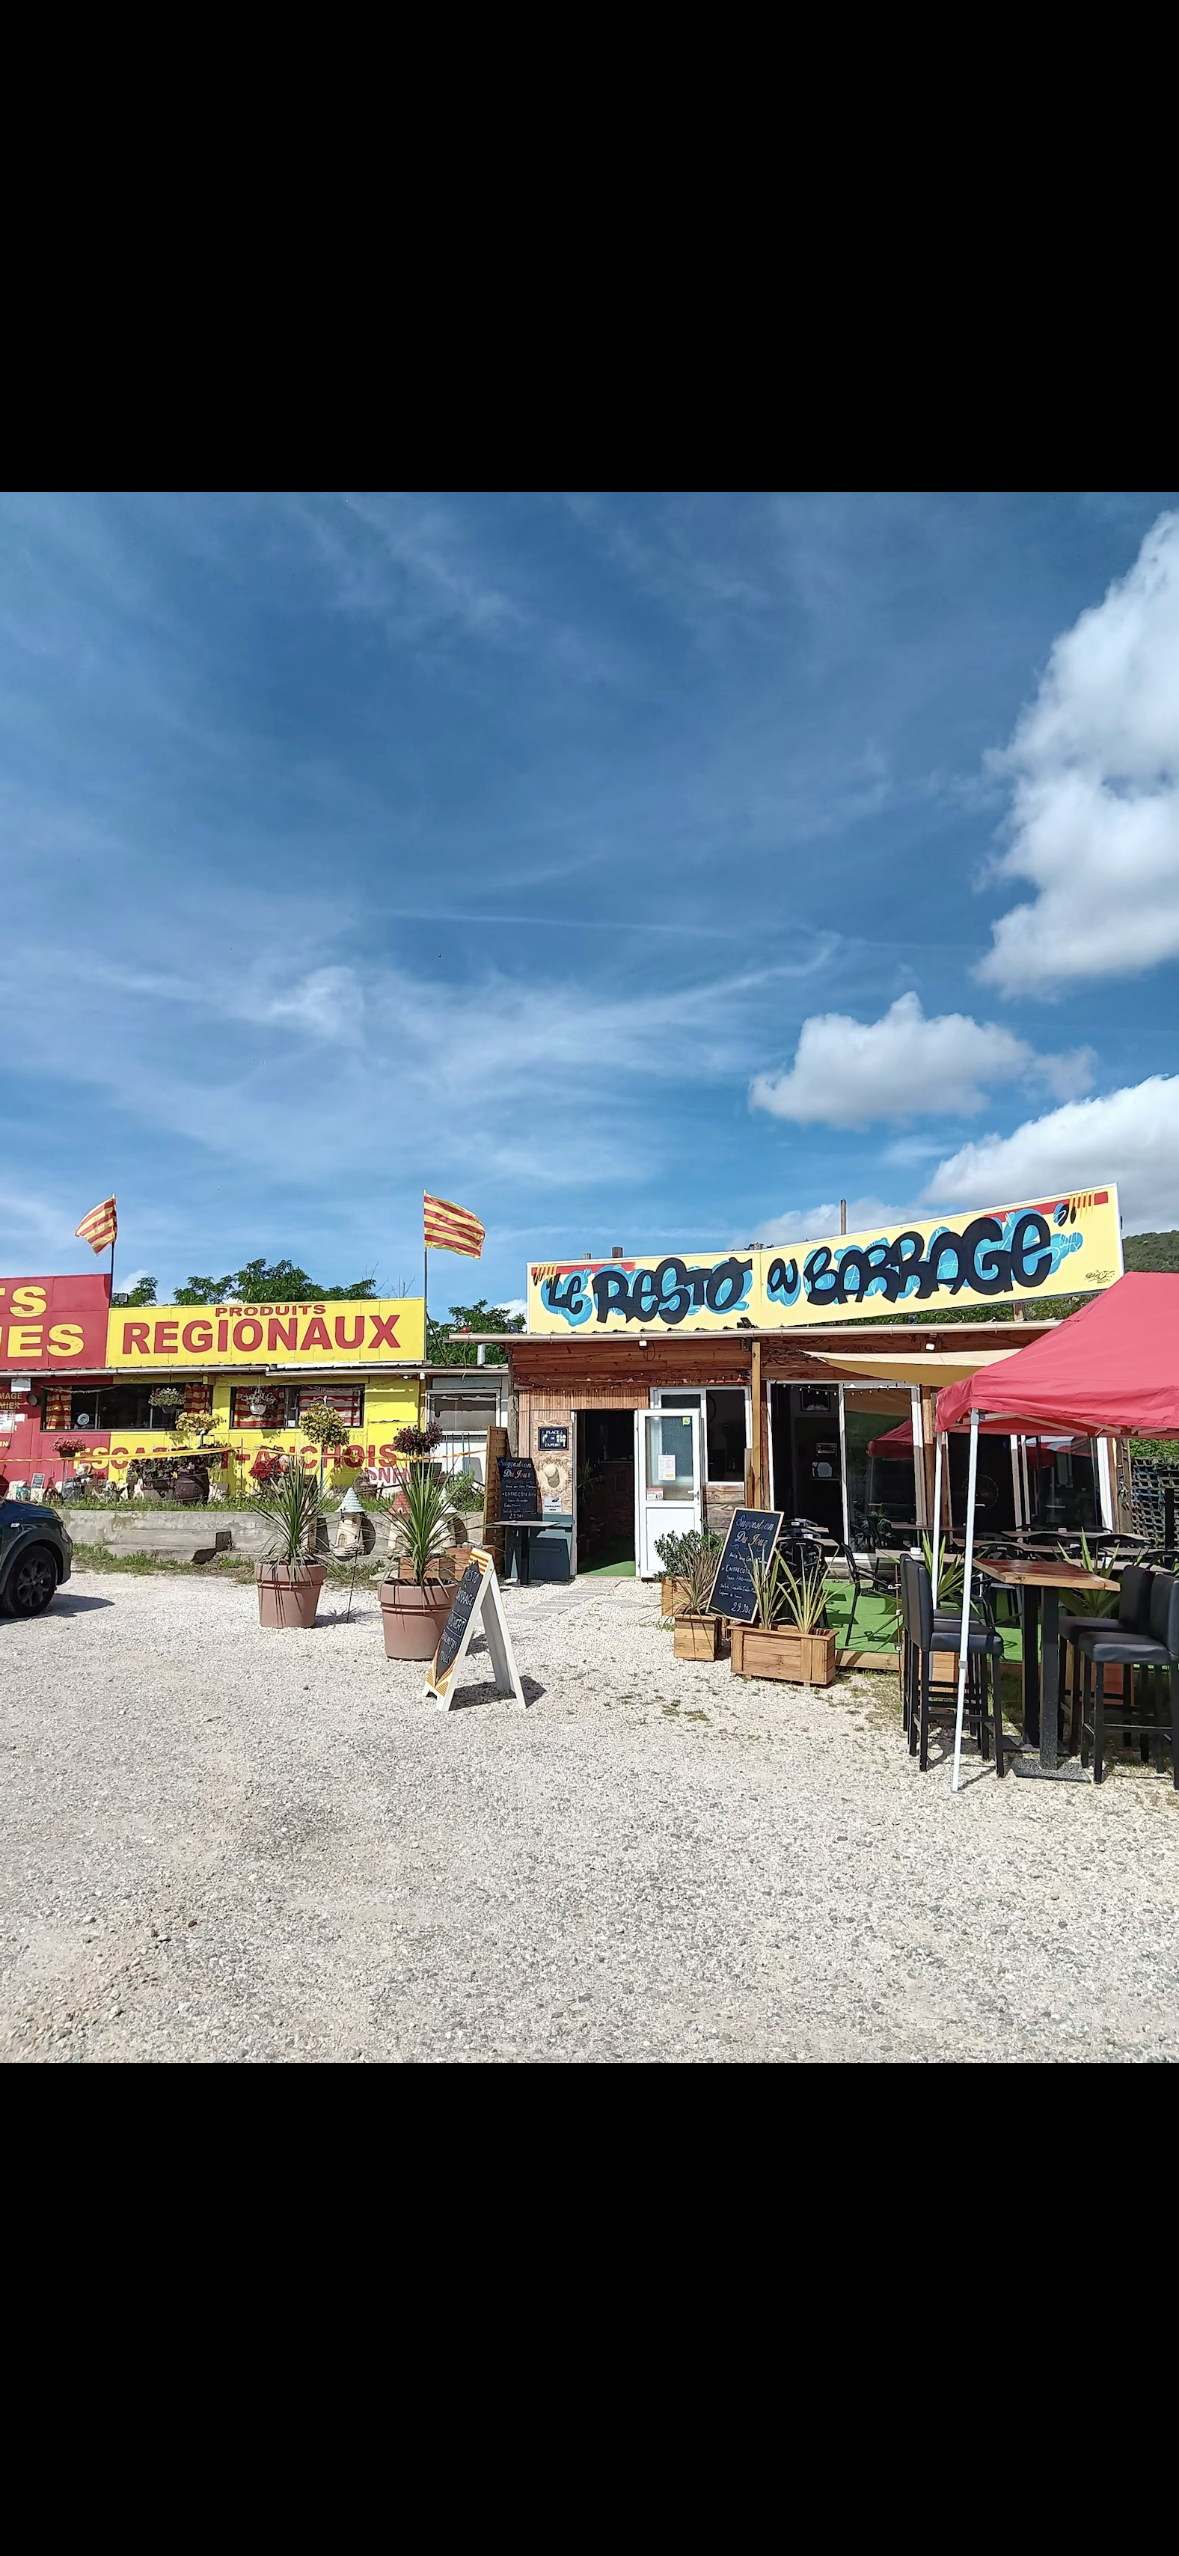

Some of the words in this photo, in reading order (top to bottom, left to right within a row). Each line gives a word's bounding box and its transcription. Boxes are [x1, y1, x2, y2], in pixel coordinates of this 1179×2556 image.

[215, 1304, 327, 1318] PRODUITS
[122, 1315, 401, 1355] REGIONAUX
[736, 1514, 775, 1532] Suggestion
